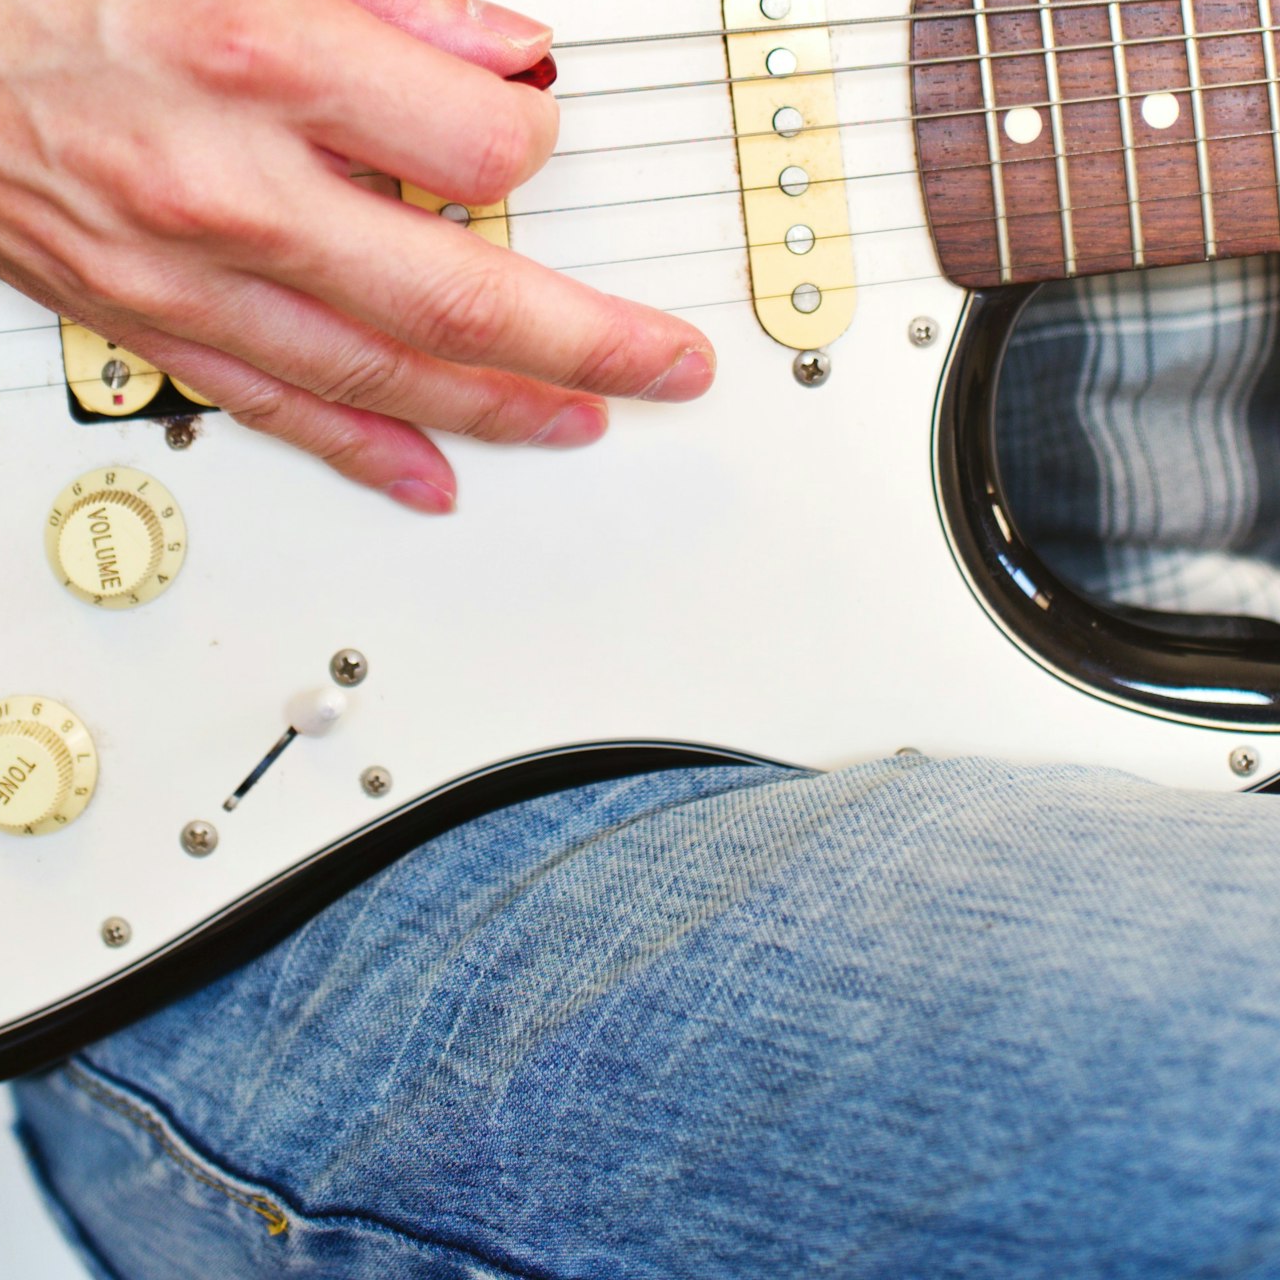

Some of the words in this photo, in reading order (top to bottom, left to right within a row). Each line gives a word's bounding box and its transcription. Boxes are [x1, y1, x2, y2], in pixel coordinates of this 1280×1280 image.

[105, 473, 116, 485] 8
[72, 483, 82, 496] 9
[137, 481, 149, 494] 7
[49, 508, 62, 527] 10
[161, 506, 175, 519] 6
[88, 506, 122, 591] VOLUME
[167, 543, 181, 551] 5
[157, 574, 169, 585] 4
[94, 595, 102, 606] 2
[129, 594, 139, 604] 3
[32, 703, 42, 715] 9
[61, 720, 74, 733] 8
[77, 753, 90, 762] 7
[75, 787, 88, 796] 6
[54, 814, 68, 824] 5
[24, 826, 34, 835] 4
